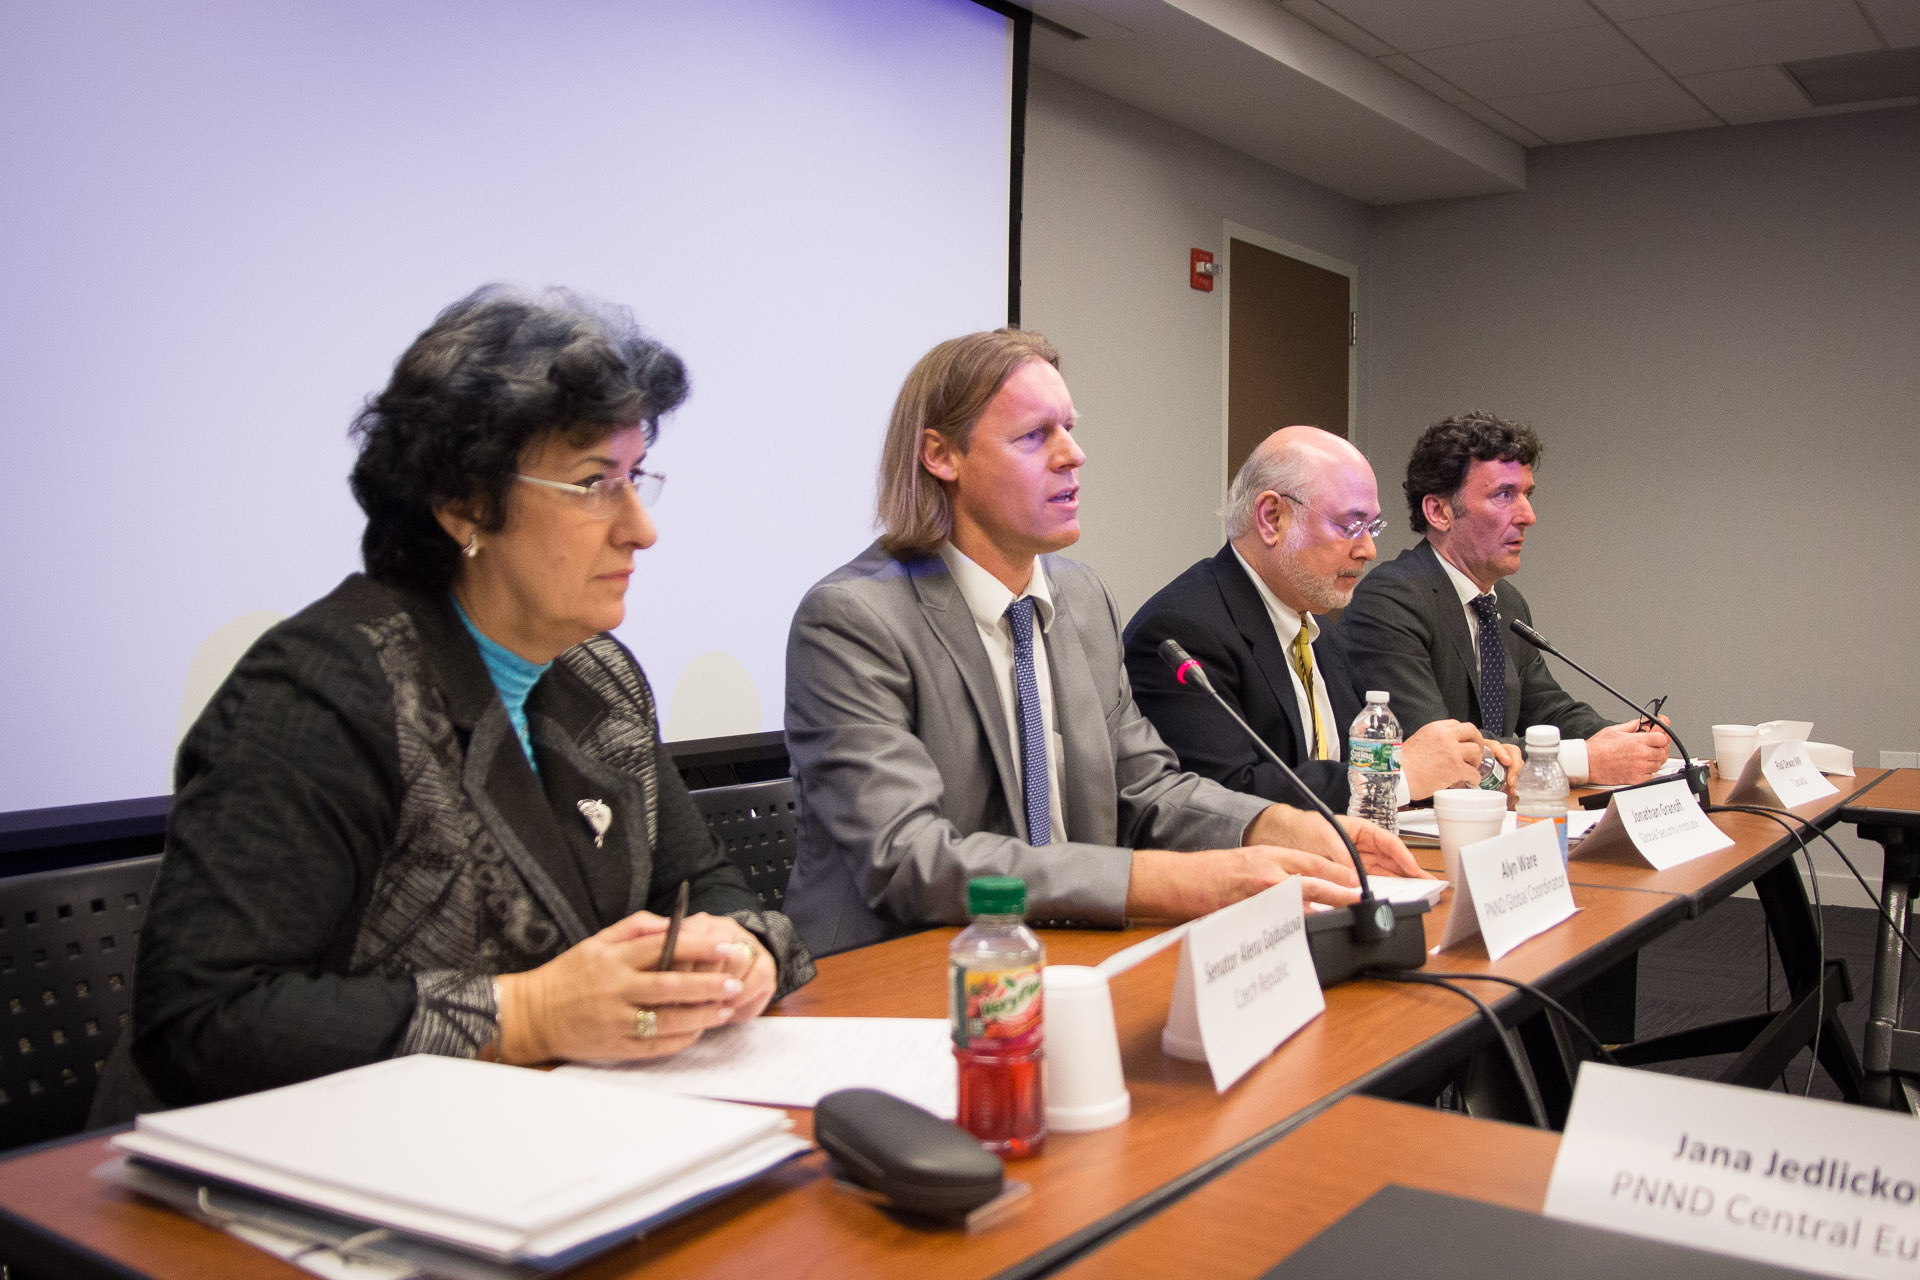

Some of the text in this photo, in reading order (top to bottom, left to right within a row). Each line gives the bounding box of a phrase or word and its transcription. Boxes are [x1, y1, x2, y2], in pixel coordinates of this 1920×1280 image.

[1631, 799, 1684, 823] Jonathan Granoff
[1501, 853, 1538, 880] Alyn Ware
[1484, 874, 1565, 920] PNND Global Coordinator
[1673, 1132, 1753, 1173] Jana
[1610, 1169, 1920, 1261] PNND Central Eu
